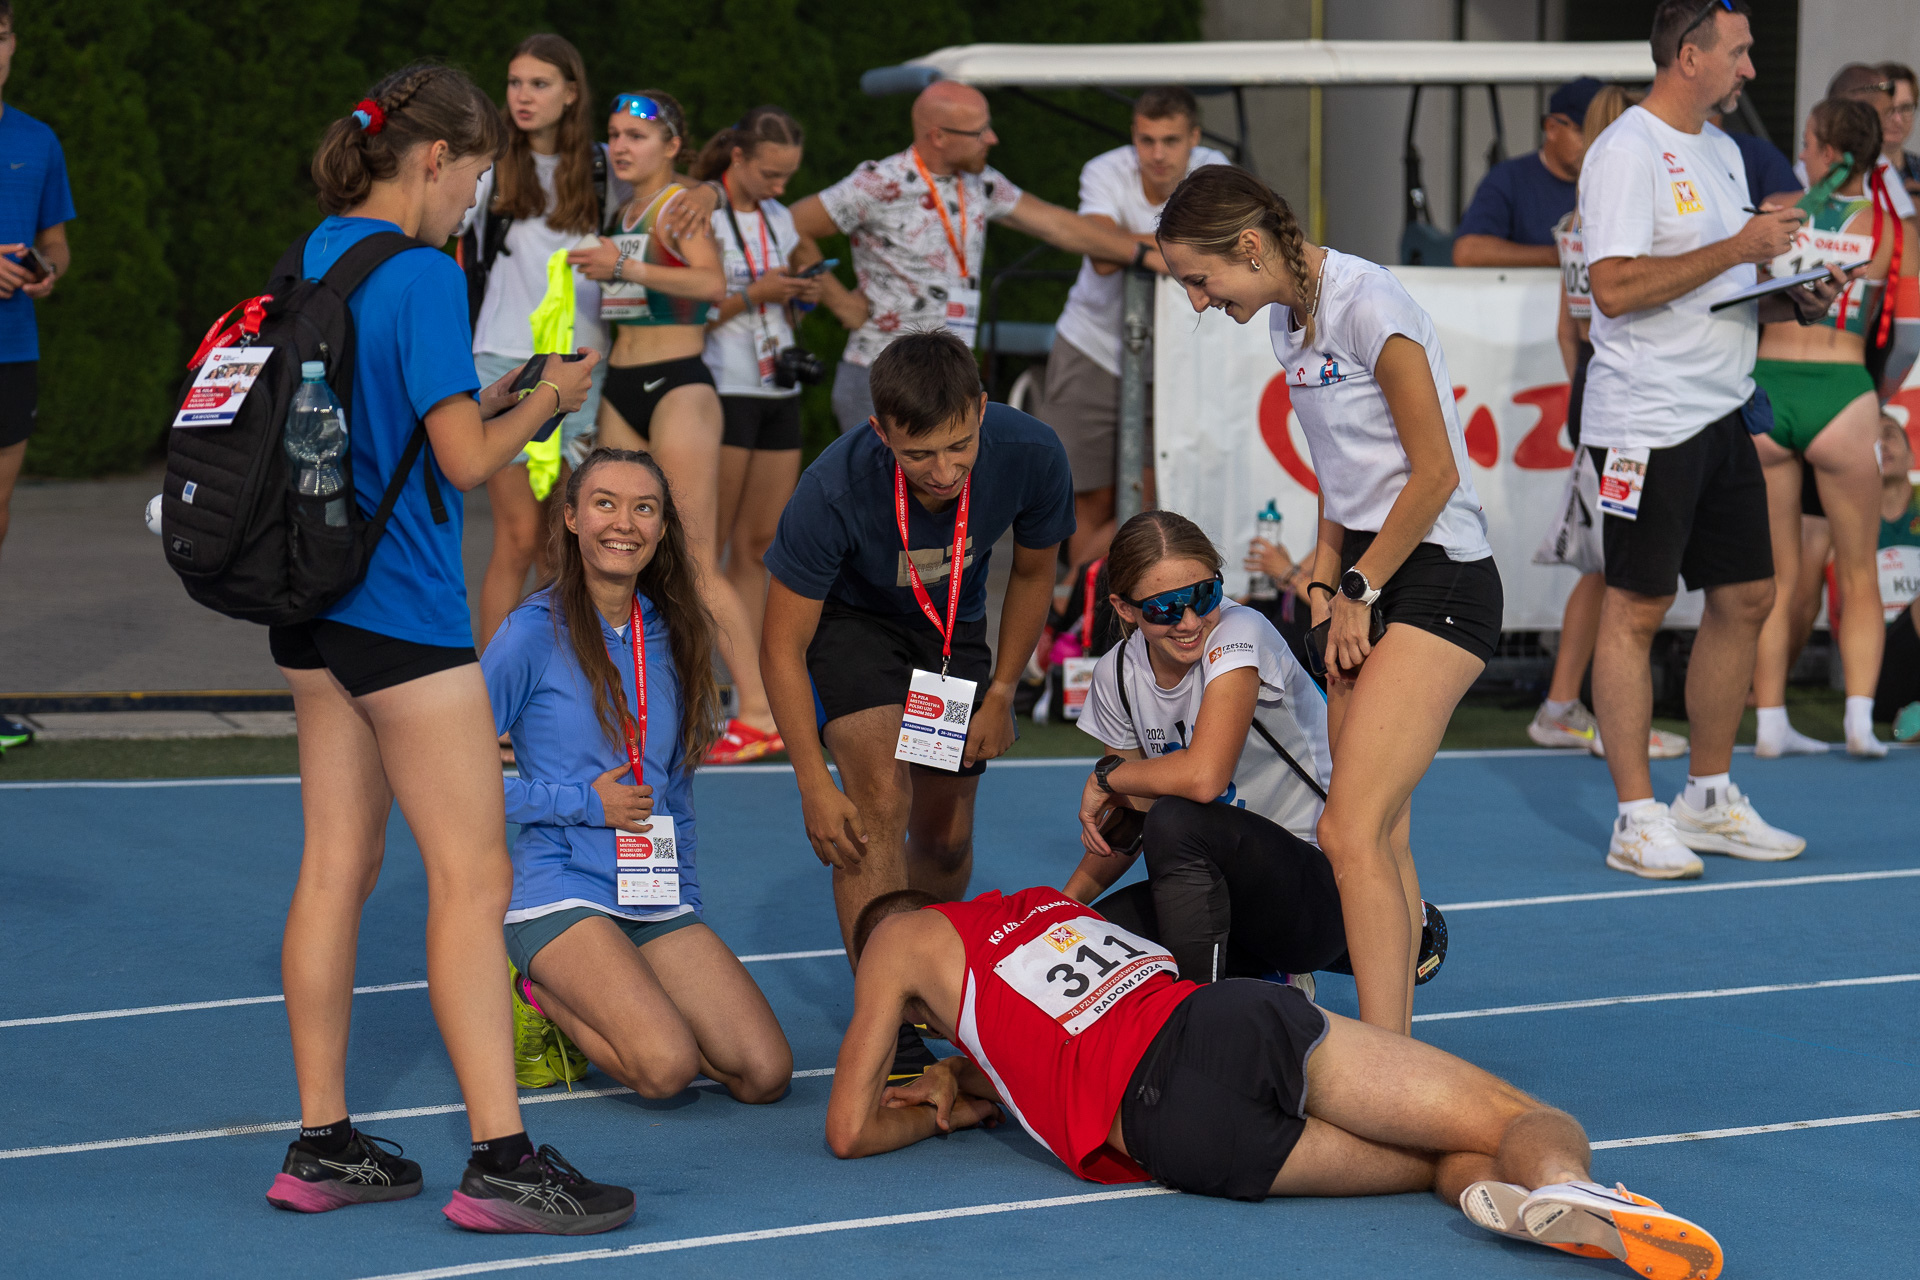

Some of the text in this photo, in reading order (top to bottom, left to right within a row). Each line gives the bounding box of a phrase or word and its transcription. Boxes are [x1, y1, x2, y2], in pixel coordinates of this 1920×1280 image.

[1815, 238, 1860, 253] ORLEN
[910, 570, 919, 589] mosir
[927, 610, 941, 626] mosir
[910, 699, 940, 708] MISTRZOSTWA
[908, 708, 924, 716] RADOM
[1146, 728, 1166, 740] 2023
[1150, 742, 1171, 754] PZLA
[988, 929, 1004, 945] KS
[1046, 935, 1149, 998] 311
[1068, 1007, 1081, 1017] 78.
[1080, 996, 1097, 1010] PZLA
[1095, 965, 1136, 997] Mistrzostwa
[1093, 963, 1163, 1014] RADOM 2024
